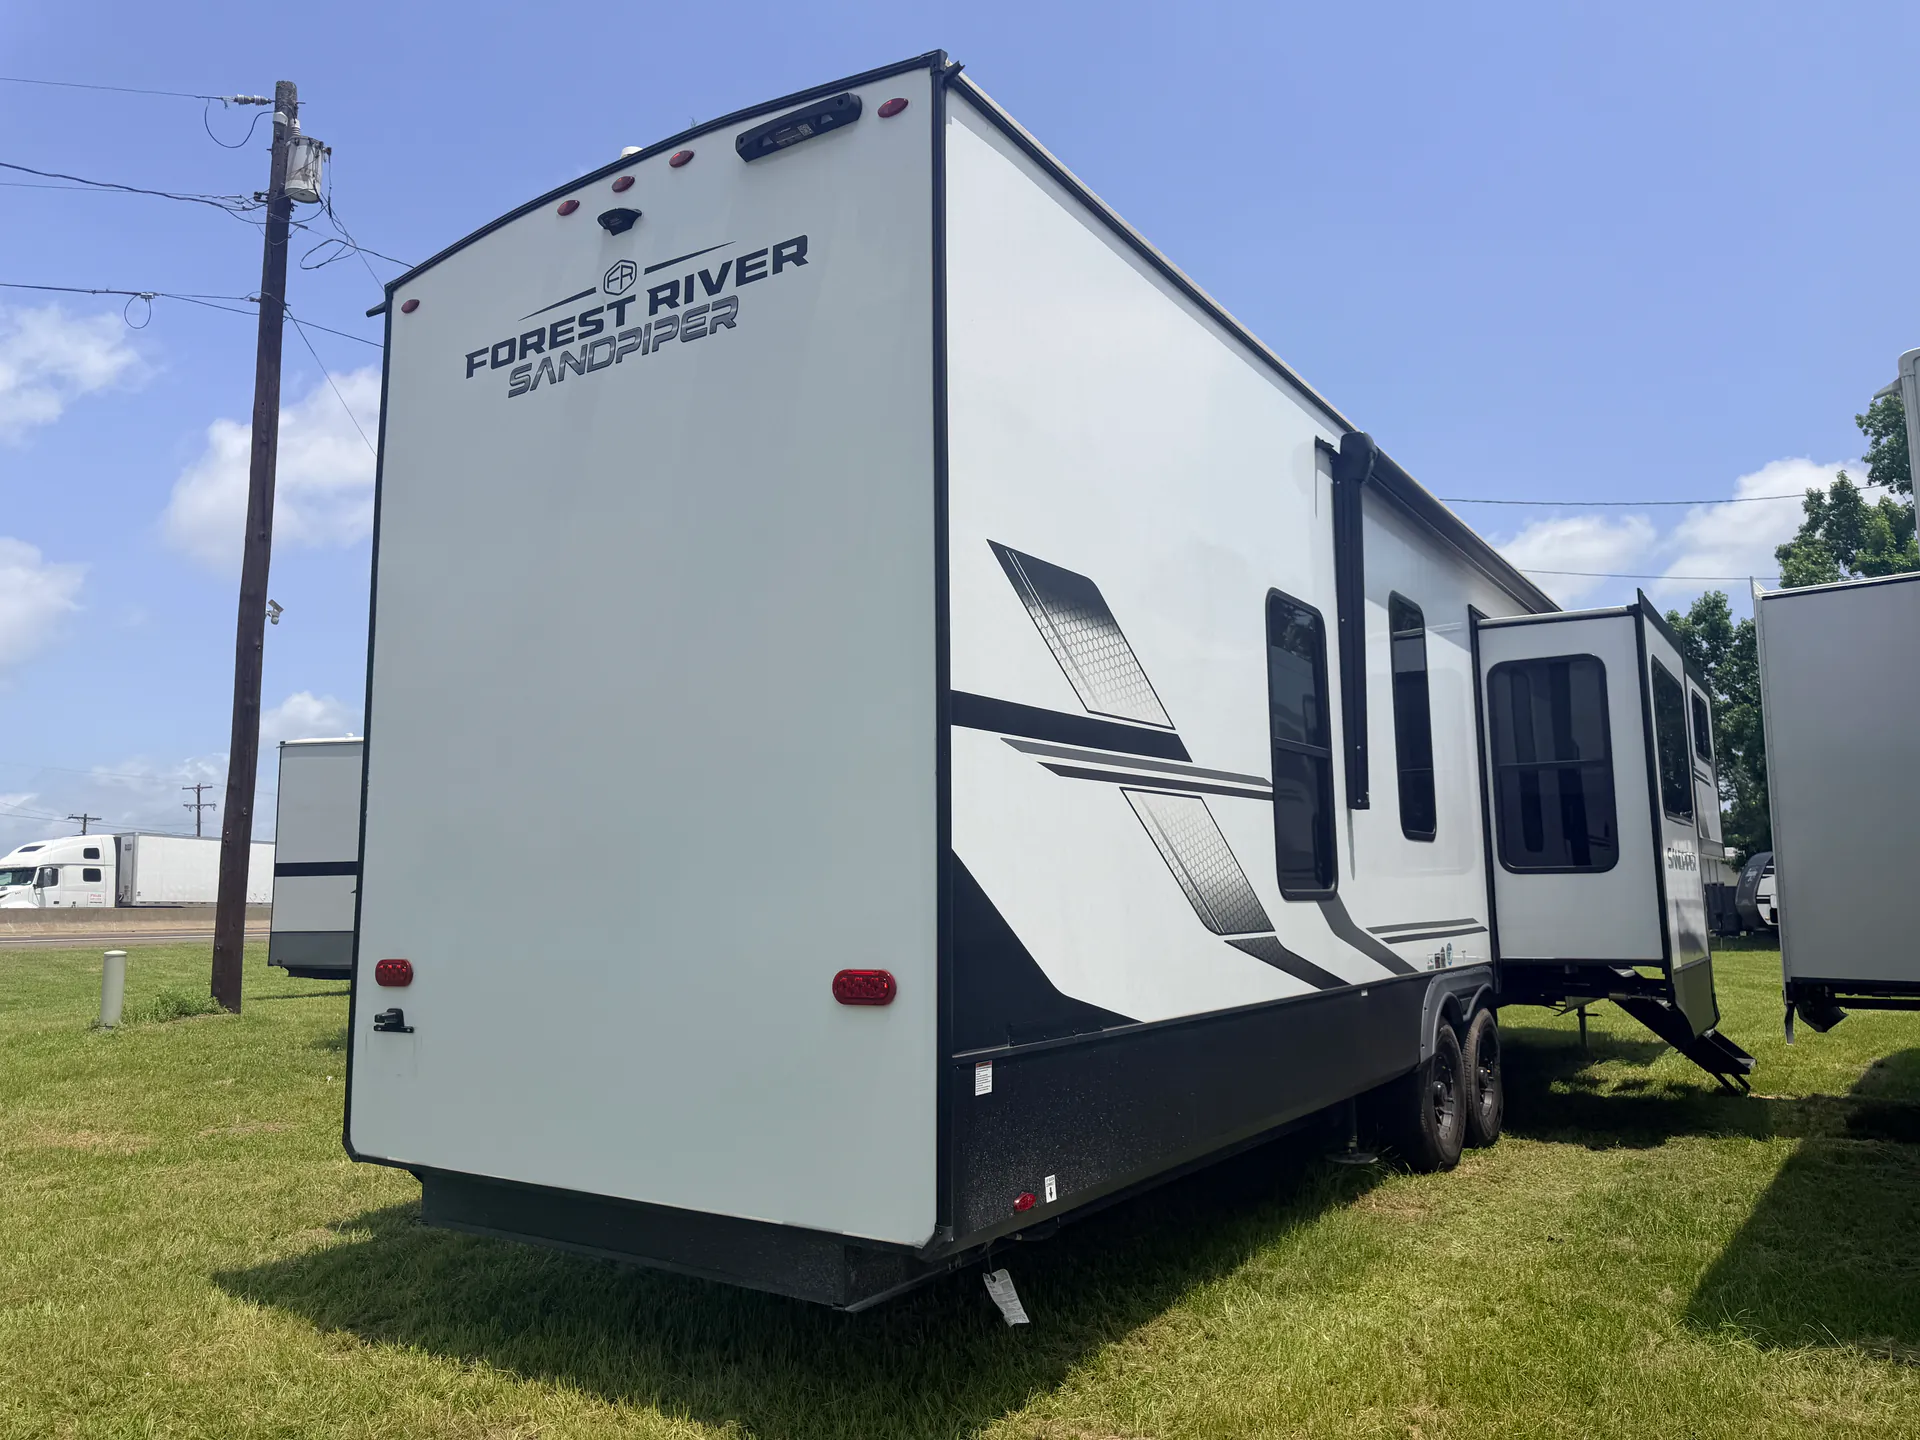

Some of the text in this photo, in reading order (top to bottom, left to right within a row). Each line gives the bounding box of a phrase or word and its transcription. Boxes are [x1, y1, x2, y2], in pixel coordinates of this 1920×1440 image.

[465, 234, 809, 380] FOREST RIVER
[507, 294, 739, 398] SANDPIPER
